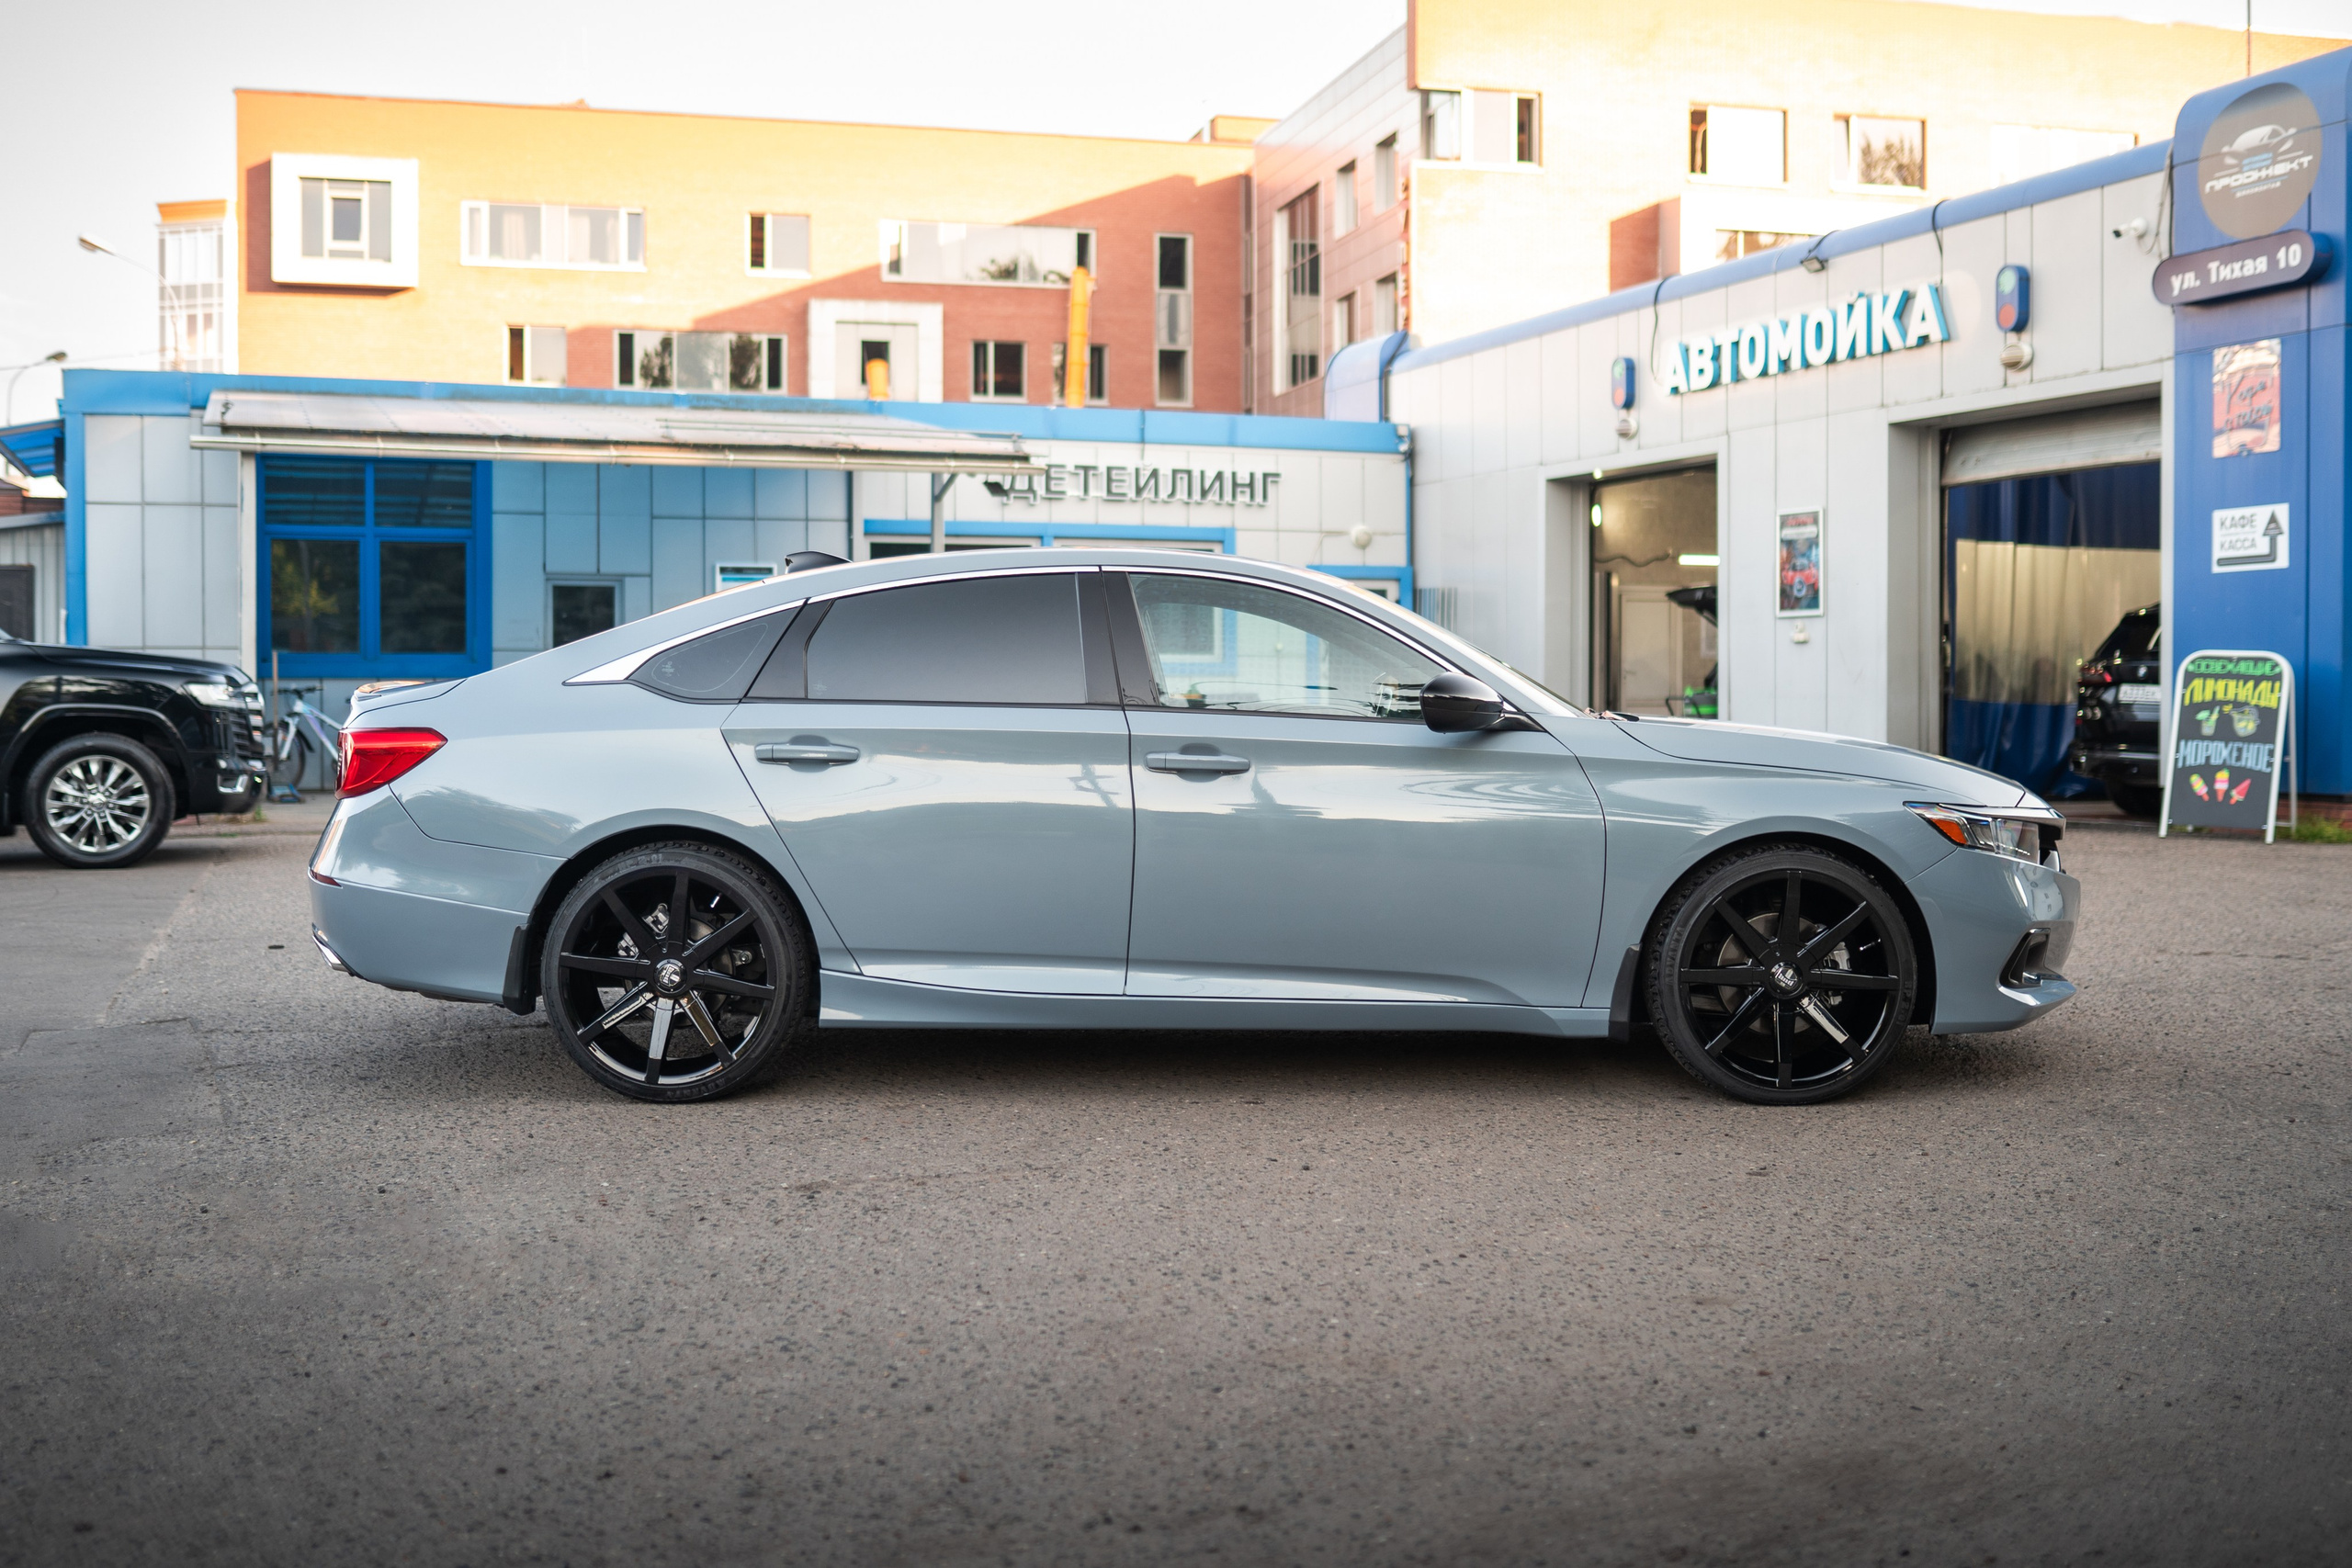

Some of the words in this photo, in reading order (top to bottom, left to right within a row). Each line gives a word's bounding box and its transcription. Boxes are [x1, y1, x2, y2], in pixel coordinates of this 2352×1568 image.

[2170, 271, 2201, 297] ул.
[2207, 260, 2268, 284] Тихая
[2276, 243, 2302, 270] 10
[1665, 283, 1949, 395] АВТОМОЙКА
[1004, 461, 1282, 505] ДЕТЕЙЛИНГ
[2220, 513, 2257, 531] КАФЕ
[2220, 536, 2257, 551] КАССА
[2184, 677, 2280, 709] ЛИМОНАДЫ
[2177, 739, 2275, 773] МОРОЖЕНОЕ
